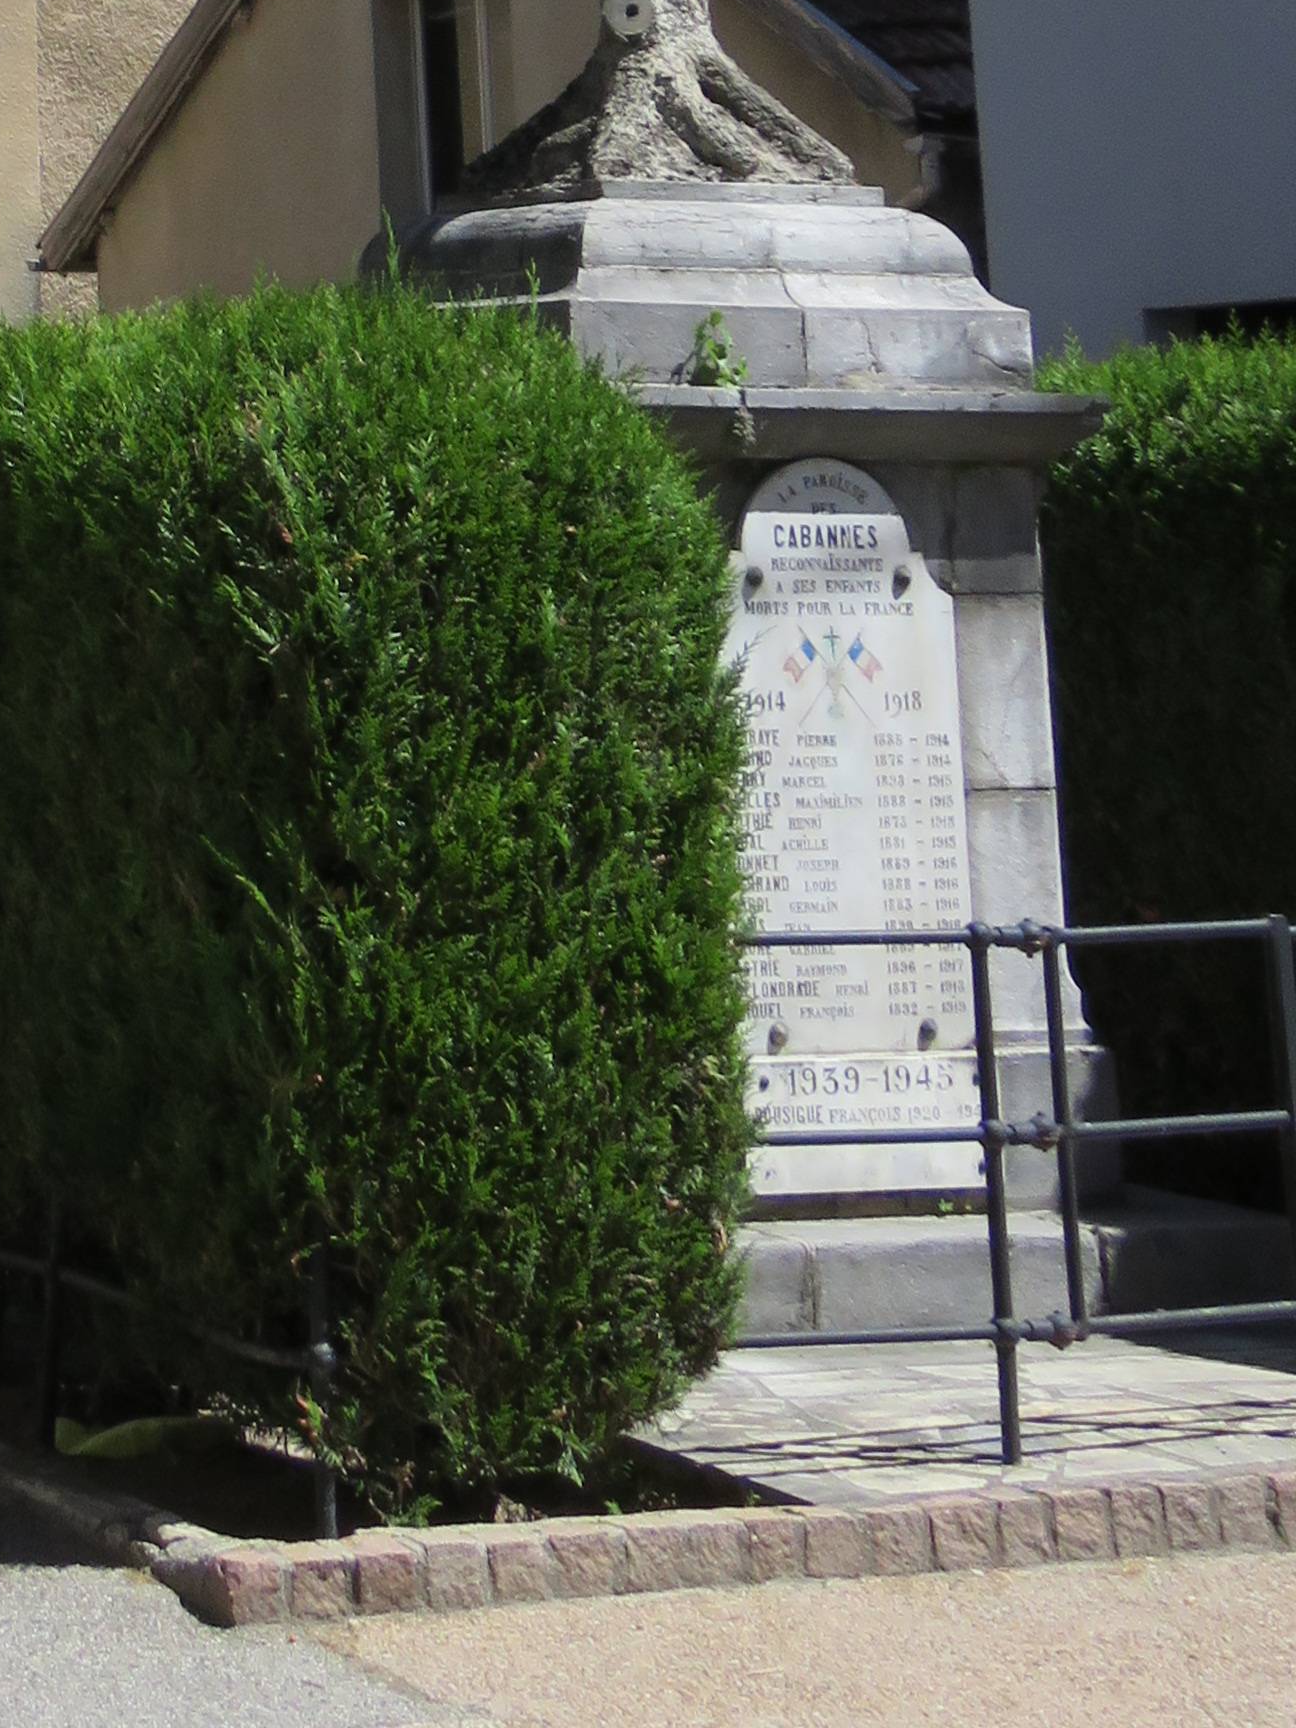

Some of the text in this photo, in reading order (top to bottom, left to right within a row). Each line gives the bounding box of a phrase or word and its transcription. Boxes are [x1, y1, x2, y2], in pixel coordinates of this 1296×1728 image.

[773, 524, 878, 549] CABANNES
[793, 580, 816, 594] SES
[826, 580, 881, 594] ENFANTS
[744, 601, 914, 617] MORTS POUR LA FRANCE
[744, 690, 785, 717] 1914
[884, 691, 922, 718] 1918
[796, 732, 837, 748] PIERRE
[788, 756, 838, 770] JACQUES
[781, 776, 827, 789] MARCEL
[781, 835, 829, 851] ACHILLE
[787, 1064, 954, 1096] 1939-1945
